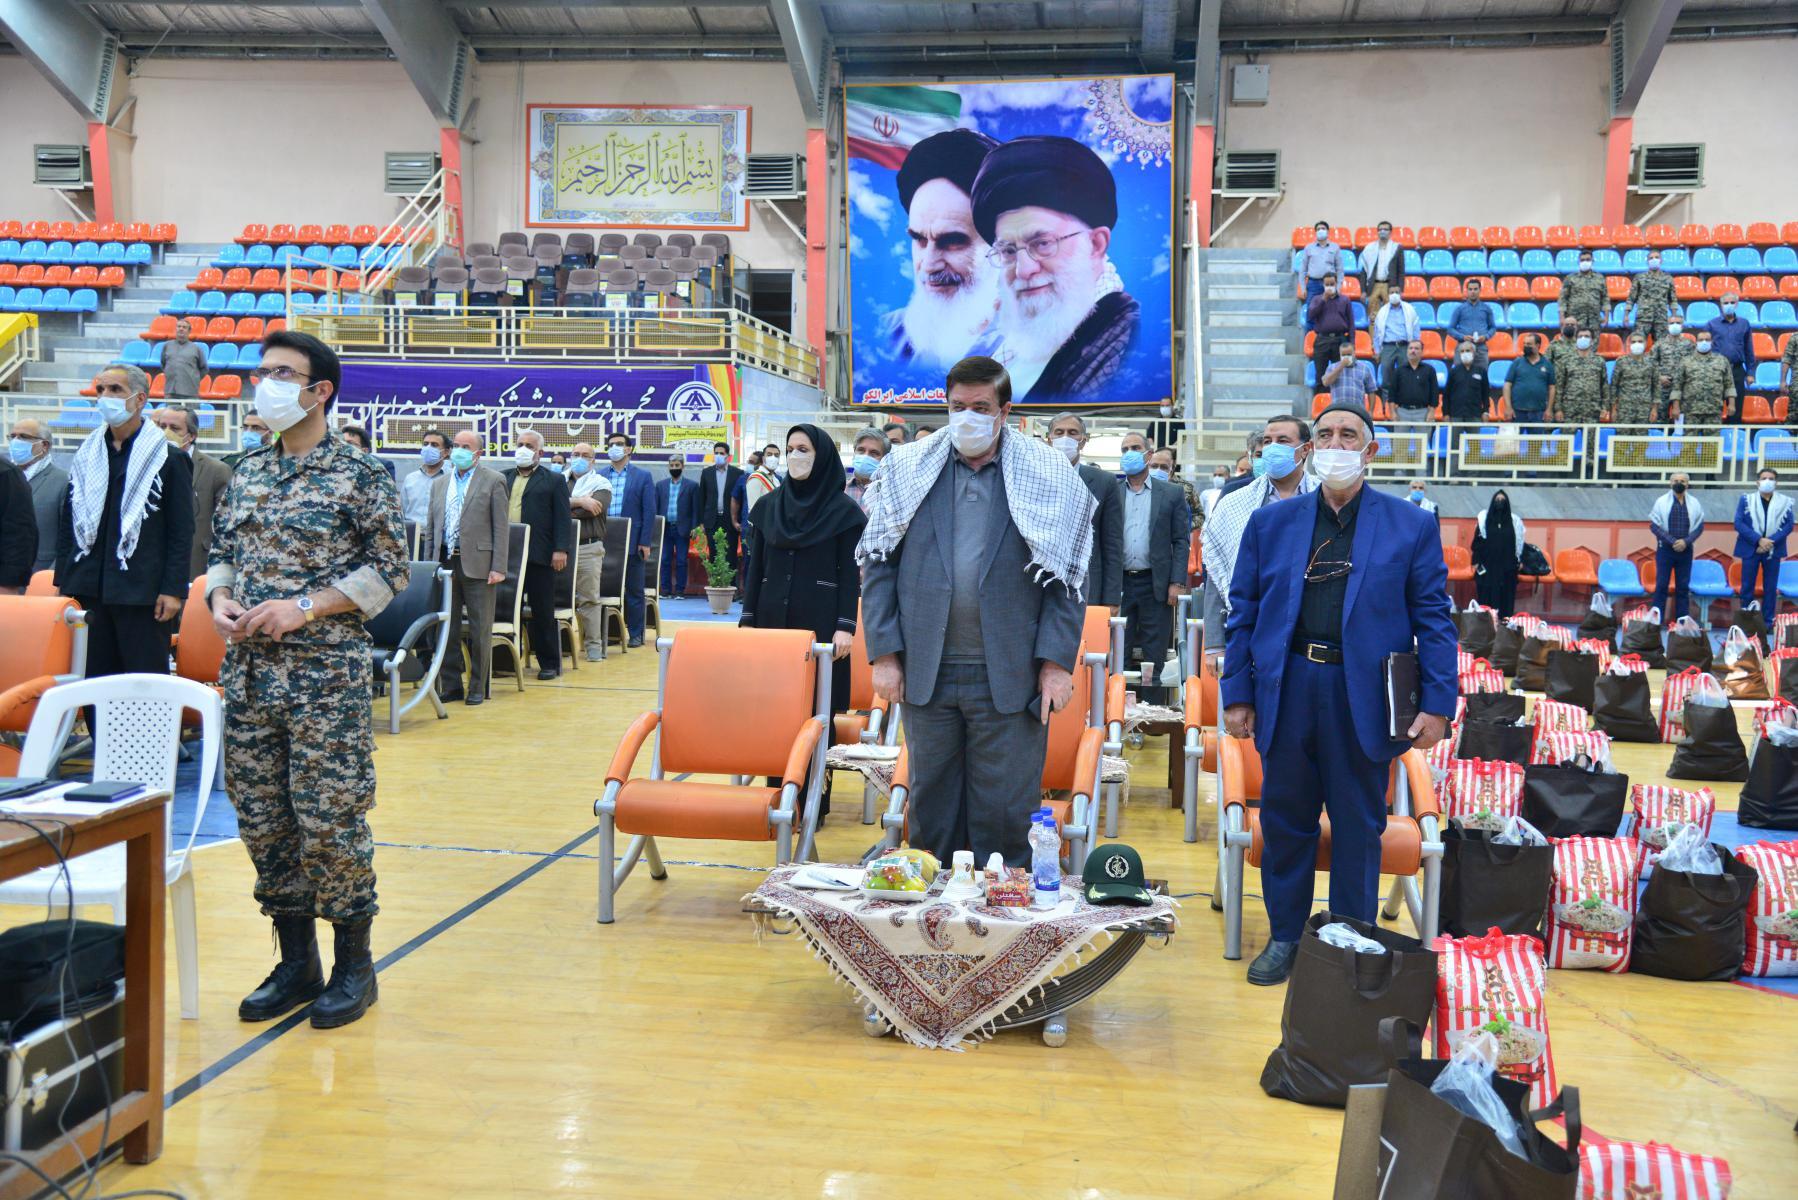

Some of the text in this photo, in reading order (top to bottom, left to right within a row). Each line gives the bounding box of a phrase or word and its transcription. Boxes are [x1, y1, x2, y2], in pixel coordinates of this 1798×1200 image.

[894, 387, 926, 404] اسلامی
[1581, 876, 1609, 886] GTC
[1481, 990, 1516, 1004] GTC
